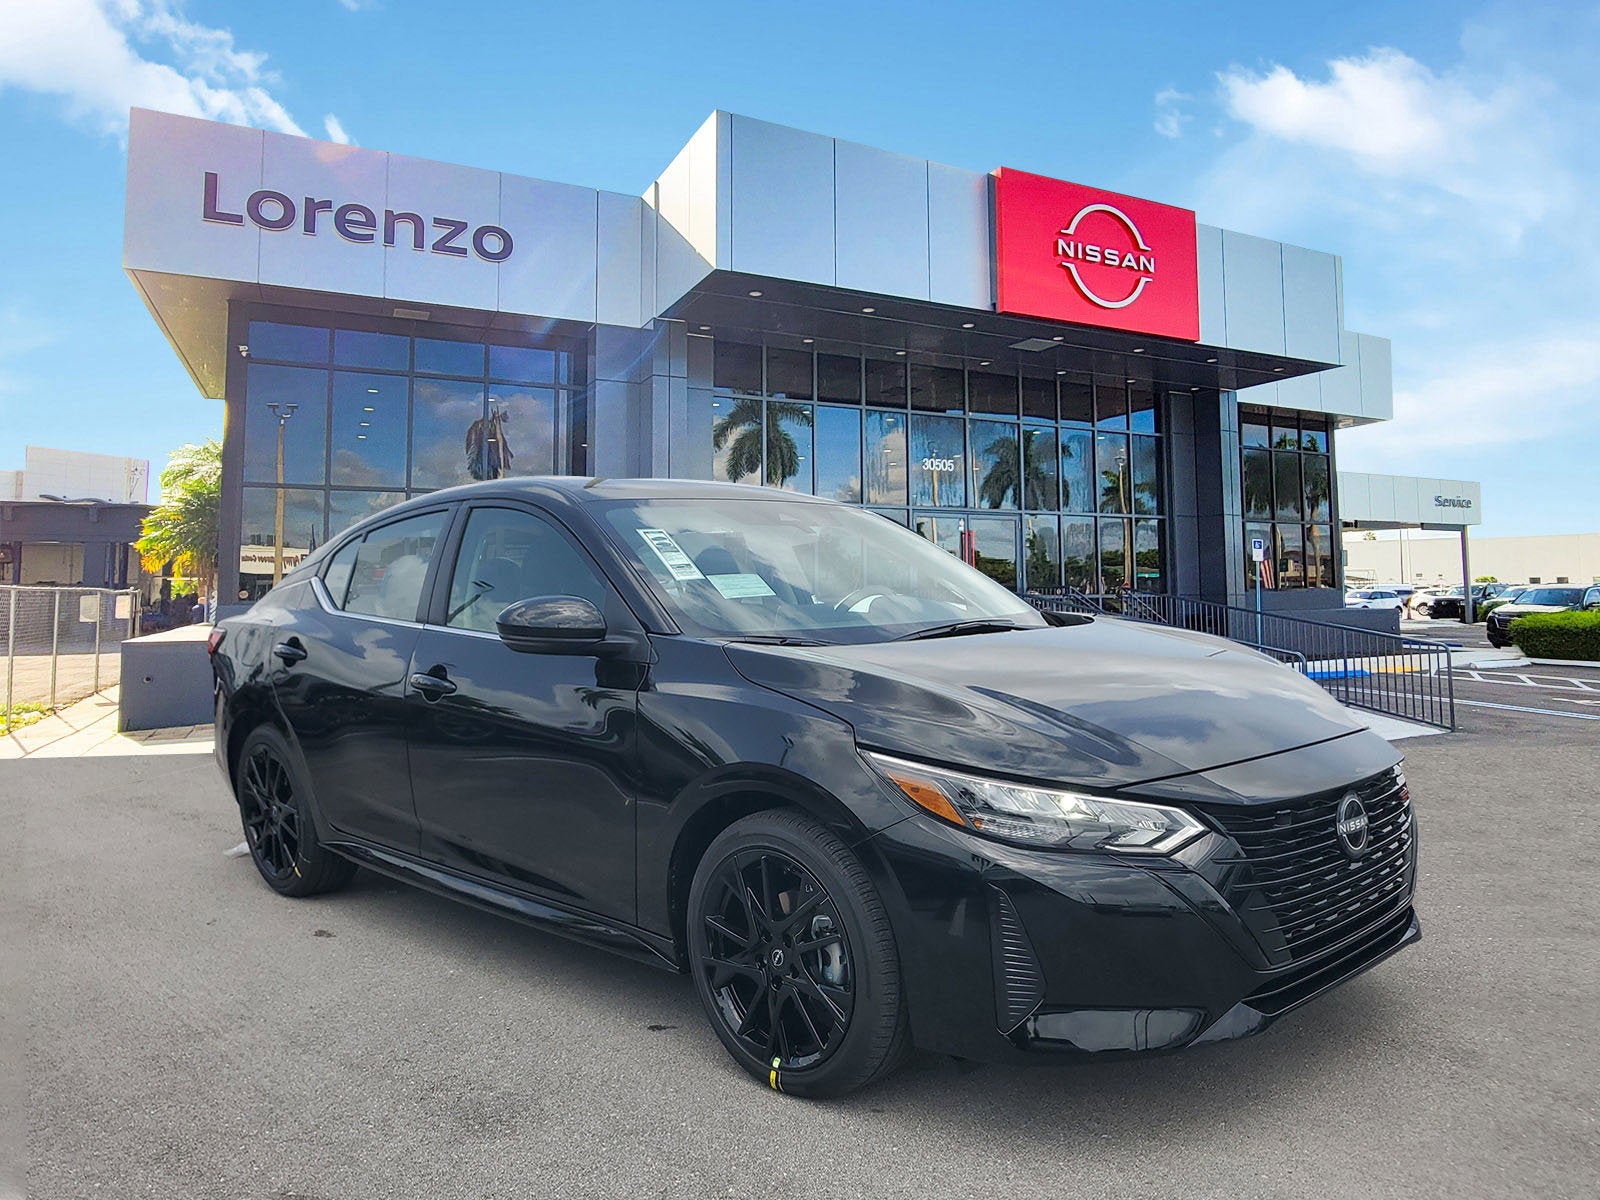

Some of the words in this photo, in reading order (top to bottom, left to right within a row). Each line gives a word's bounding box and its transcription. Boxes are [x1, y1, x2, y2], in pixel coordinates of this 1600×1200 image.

[202, 170, 514, 263] Lorenzo
[1056, 238, 1155, 273] NISSAN
[922, 457, 954, 472] 30505
[1434, 495, 1472, 508] Service
[1339, 814, 1369, 833] NISSAN
